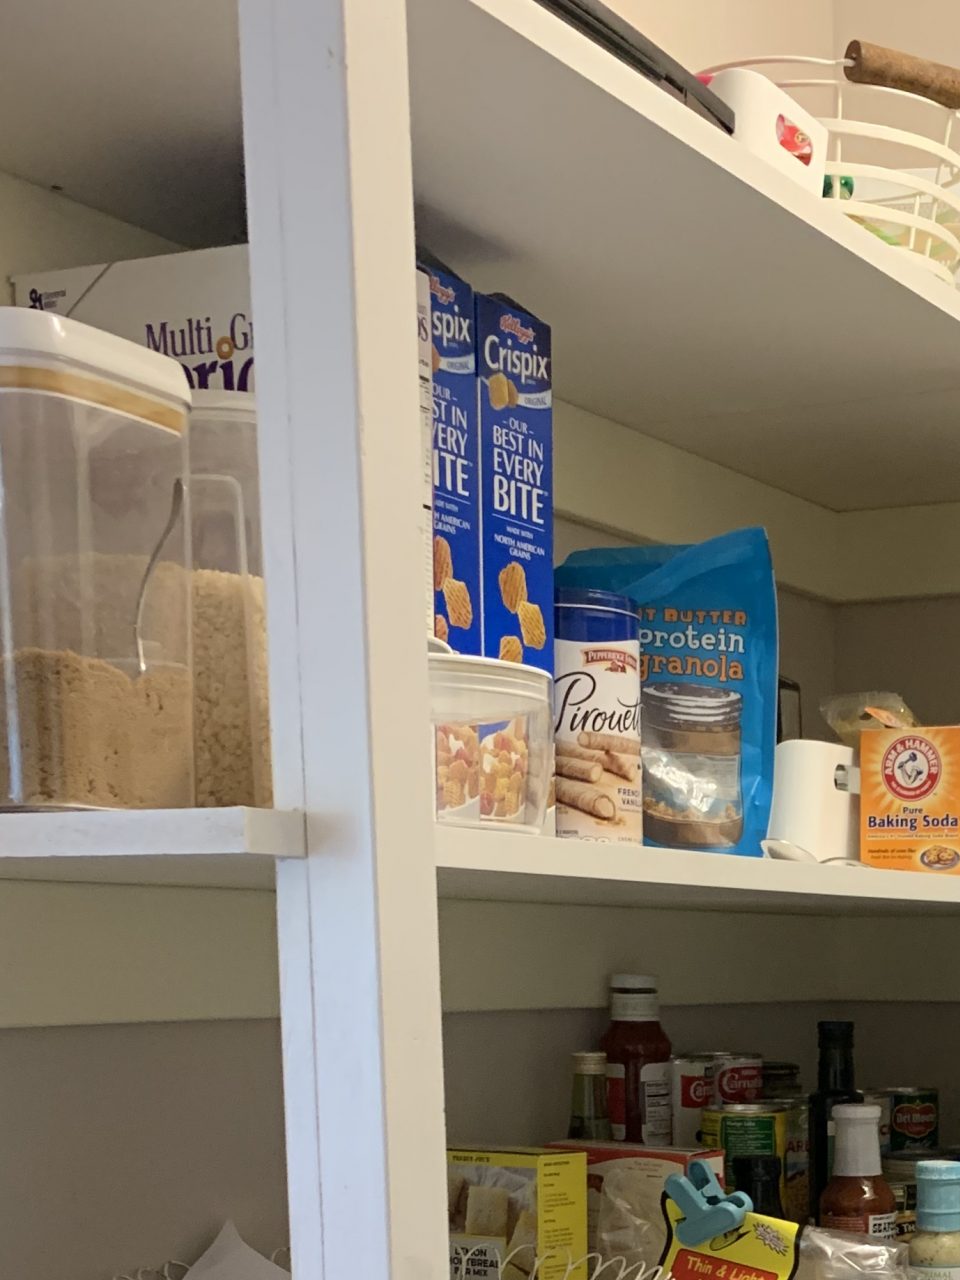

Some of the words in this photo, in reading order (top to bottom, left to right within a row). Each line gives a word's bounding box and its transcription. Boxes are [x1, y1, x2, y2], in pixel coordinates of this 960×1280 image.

[145, 316, 214, 357] Multi
[432, 304, 471, 348] spix
[484, 334, 548, 385] Crispix
[433, 399, 447, 421] ST
[452, 406, 467, 430] IN
[509, 417, 527, 434] OUR
[432, 422, 467, 456] ERY
[493, 425, 524, 453] BEST
[528, 438, 544, 461] IN
[434, 449, 470, 497] ITE
[493, 448, 544, 487] EVERY
[493, 474, 545, 524] BITE
[664, 608, 747, 626] BUTTER
[640, 625, 745, 653] protein
[640, 654, 744, 682] granola
[554, 671, 641, 734] Pirouett
[885, 749, 899, 775] ARM
[905, 739, 938, 774] HAMMER
[617, 787, 640, 798] FRENC
[621, 798, 641, 807] VANIL
[868, 815, 917, 831] Baking
[923, 813, 958, 828] Soda
[903, 806, 923, 815] Pure
[473, 1268, 488, 1277] MIX
[687, 1255, 713, 1275] Thin
[716, 1266, 727, 1279] &
